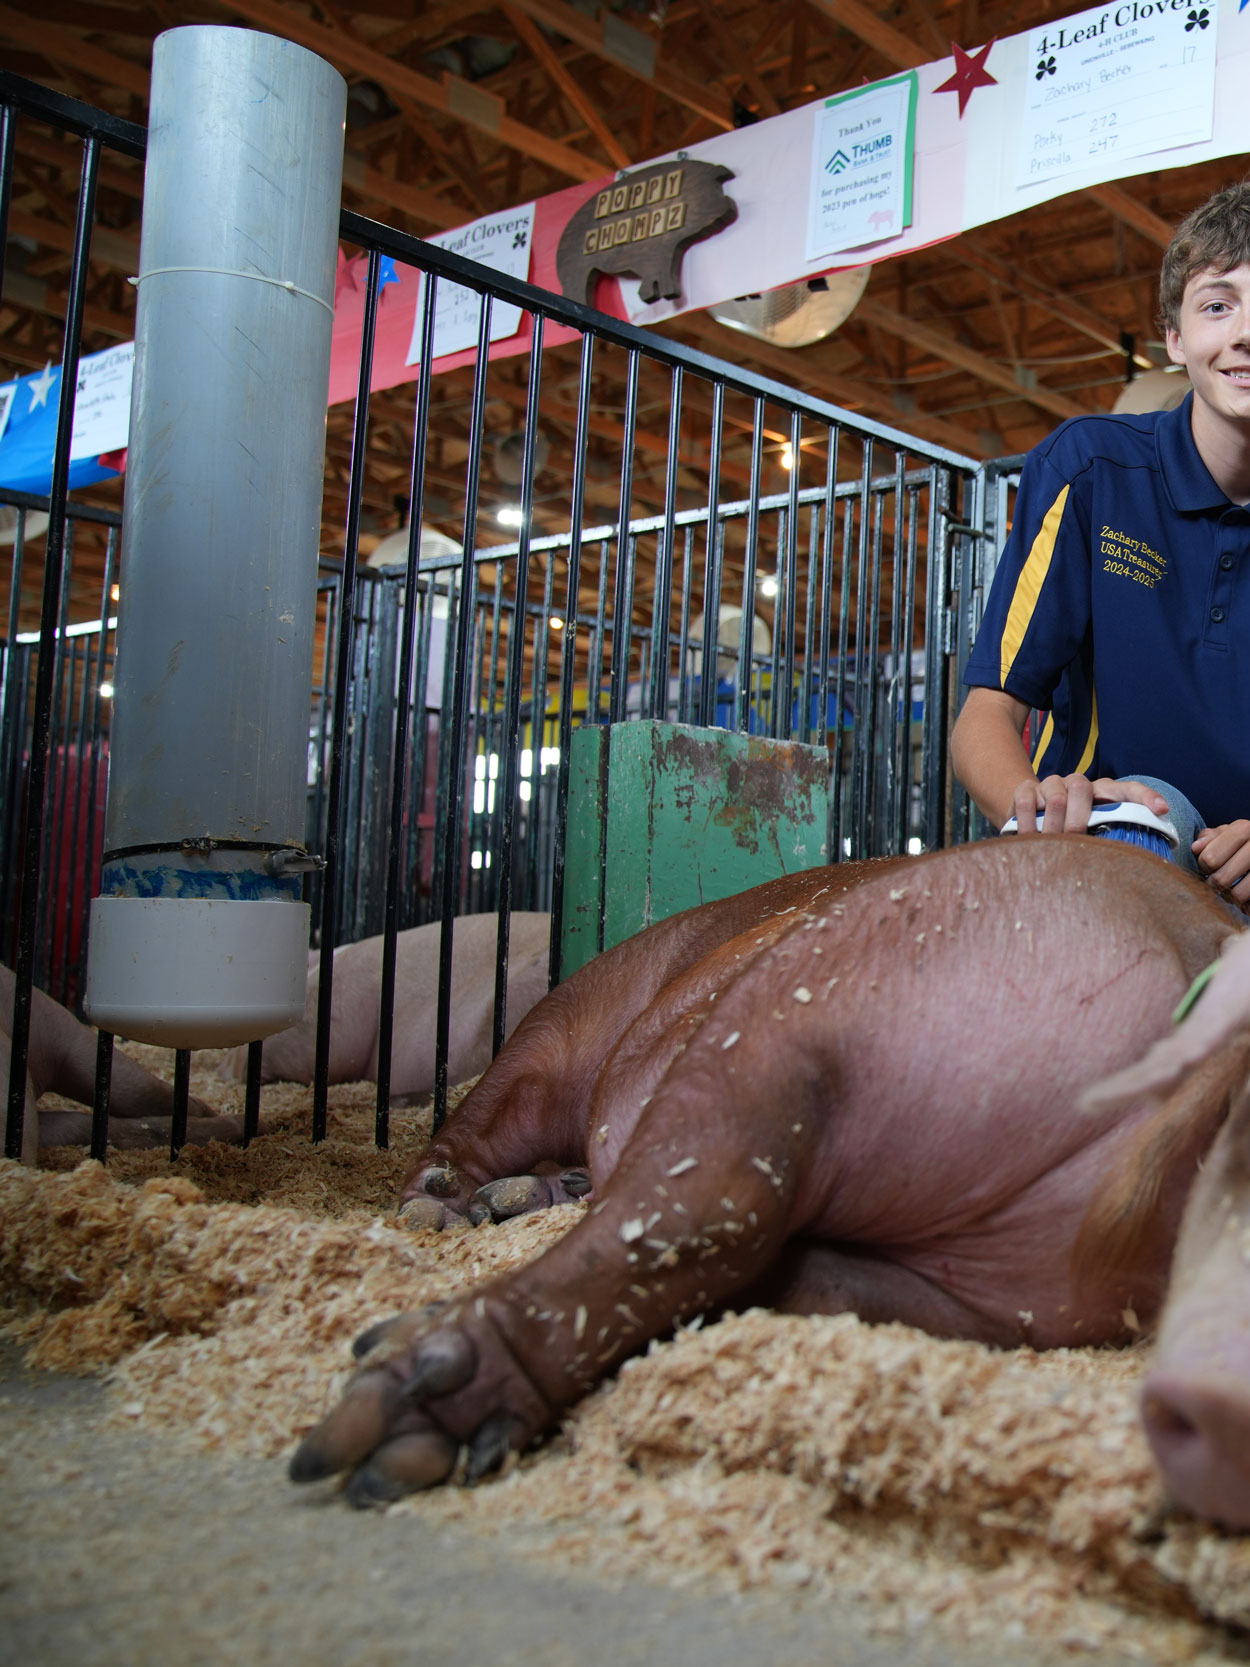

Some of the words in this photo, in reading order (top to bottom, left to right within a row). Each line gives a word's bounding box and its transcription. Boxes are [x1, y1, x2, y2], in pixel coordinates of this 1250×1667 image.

[1036, 13, 1109, 57] 4-Leaf
[1113, 28, 1138, 43] CLUB
[1182, 45, 1197, 65] 17
[1044, 78, 1092, 103] Zachary
[838, 123, 864, 138] Thank
[866, 116, 882, 129] You
[1089, 112, 1119, 133] 272
[852, 134, 893, 159] THUMB
[1088, 134, 1119, 155] 247
[1029, 152, 1072, 174] Priscilla
[595, 172, 680, 217] POPPY
[834, 174, 880, 196] purchasing
[881, 170, 893, 181] my
[821, 201, 841, 214] 2023
[842, 198, 858, 212] pen
[859, 191, 869, 203] of
[471, 215, 530, 243] Clovers
[584, 204, 682, 253] CHOMPZ
[1100, 525, 1141, 552] Zachary
[1141, 542, 1168, 568] Becker
[1100, 541, 1122, 558] USA
[1123, 548, 1163, 578] Treasurer
[1103, 559, 1156, 589] 2024-2025
